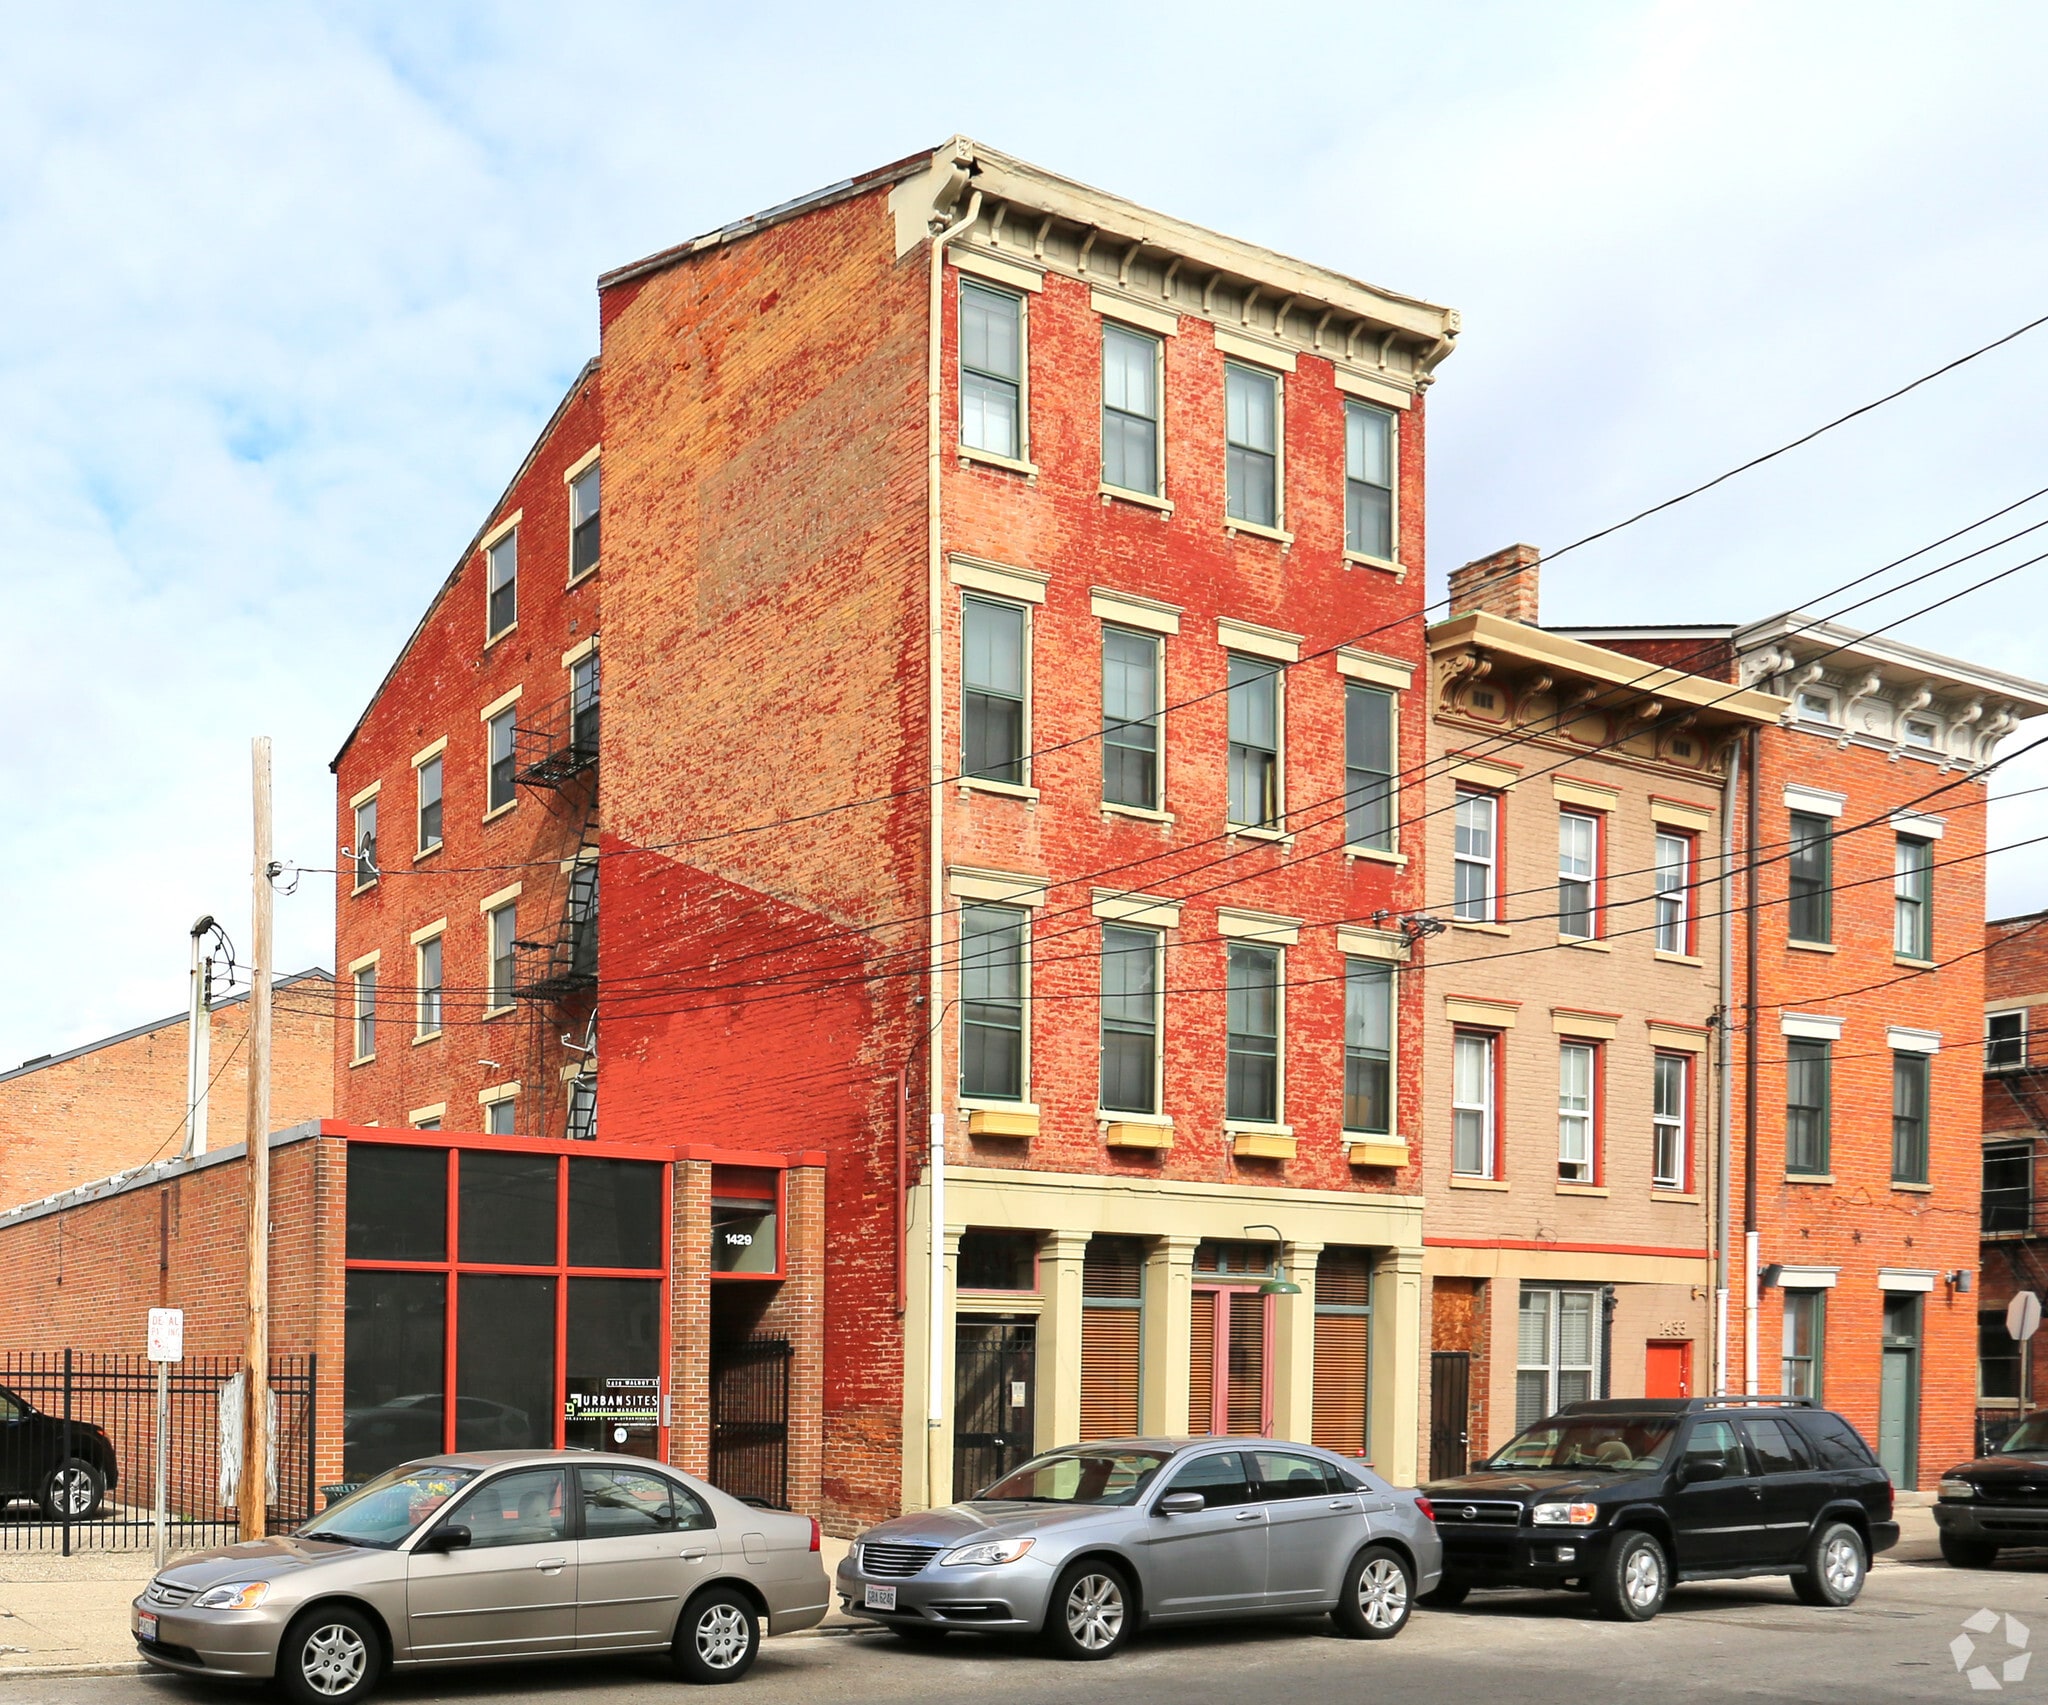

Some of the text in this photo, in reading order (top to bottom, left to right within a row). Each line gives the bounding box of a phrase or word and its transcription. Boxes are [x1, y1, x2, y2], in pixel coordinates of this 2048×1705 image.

[725, 1234, 752, 1245] 1429
[152, 1316, 179, 1325] DEAL
[583, 1395, 657, 1406] URBAN SITES
